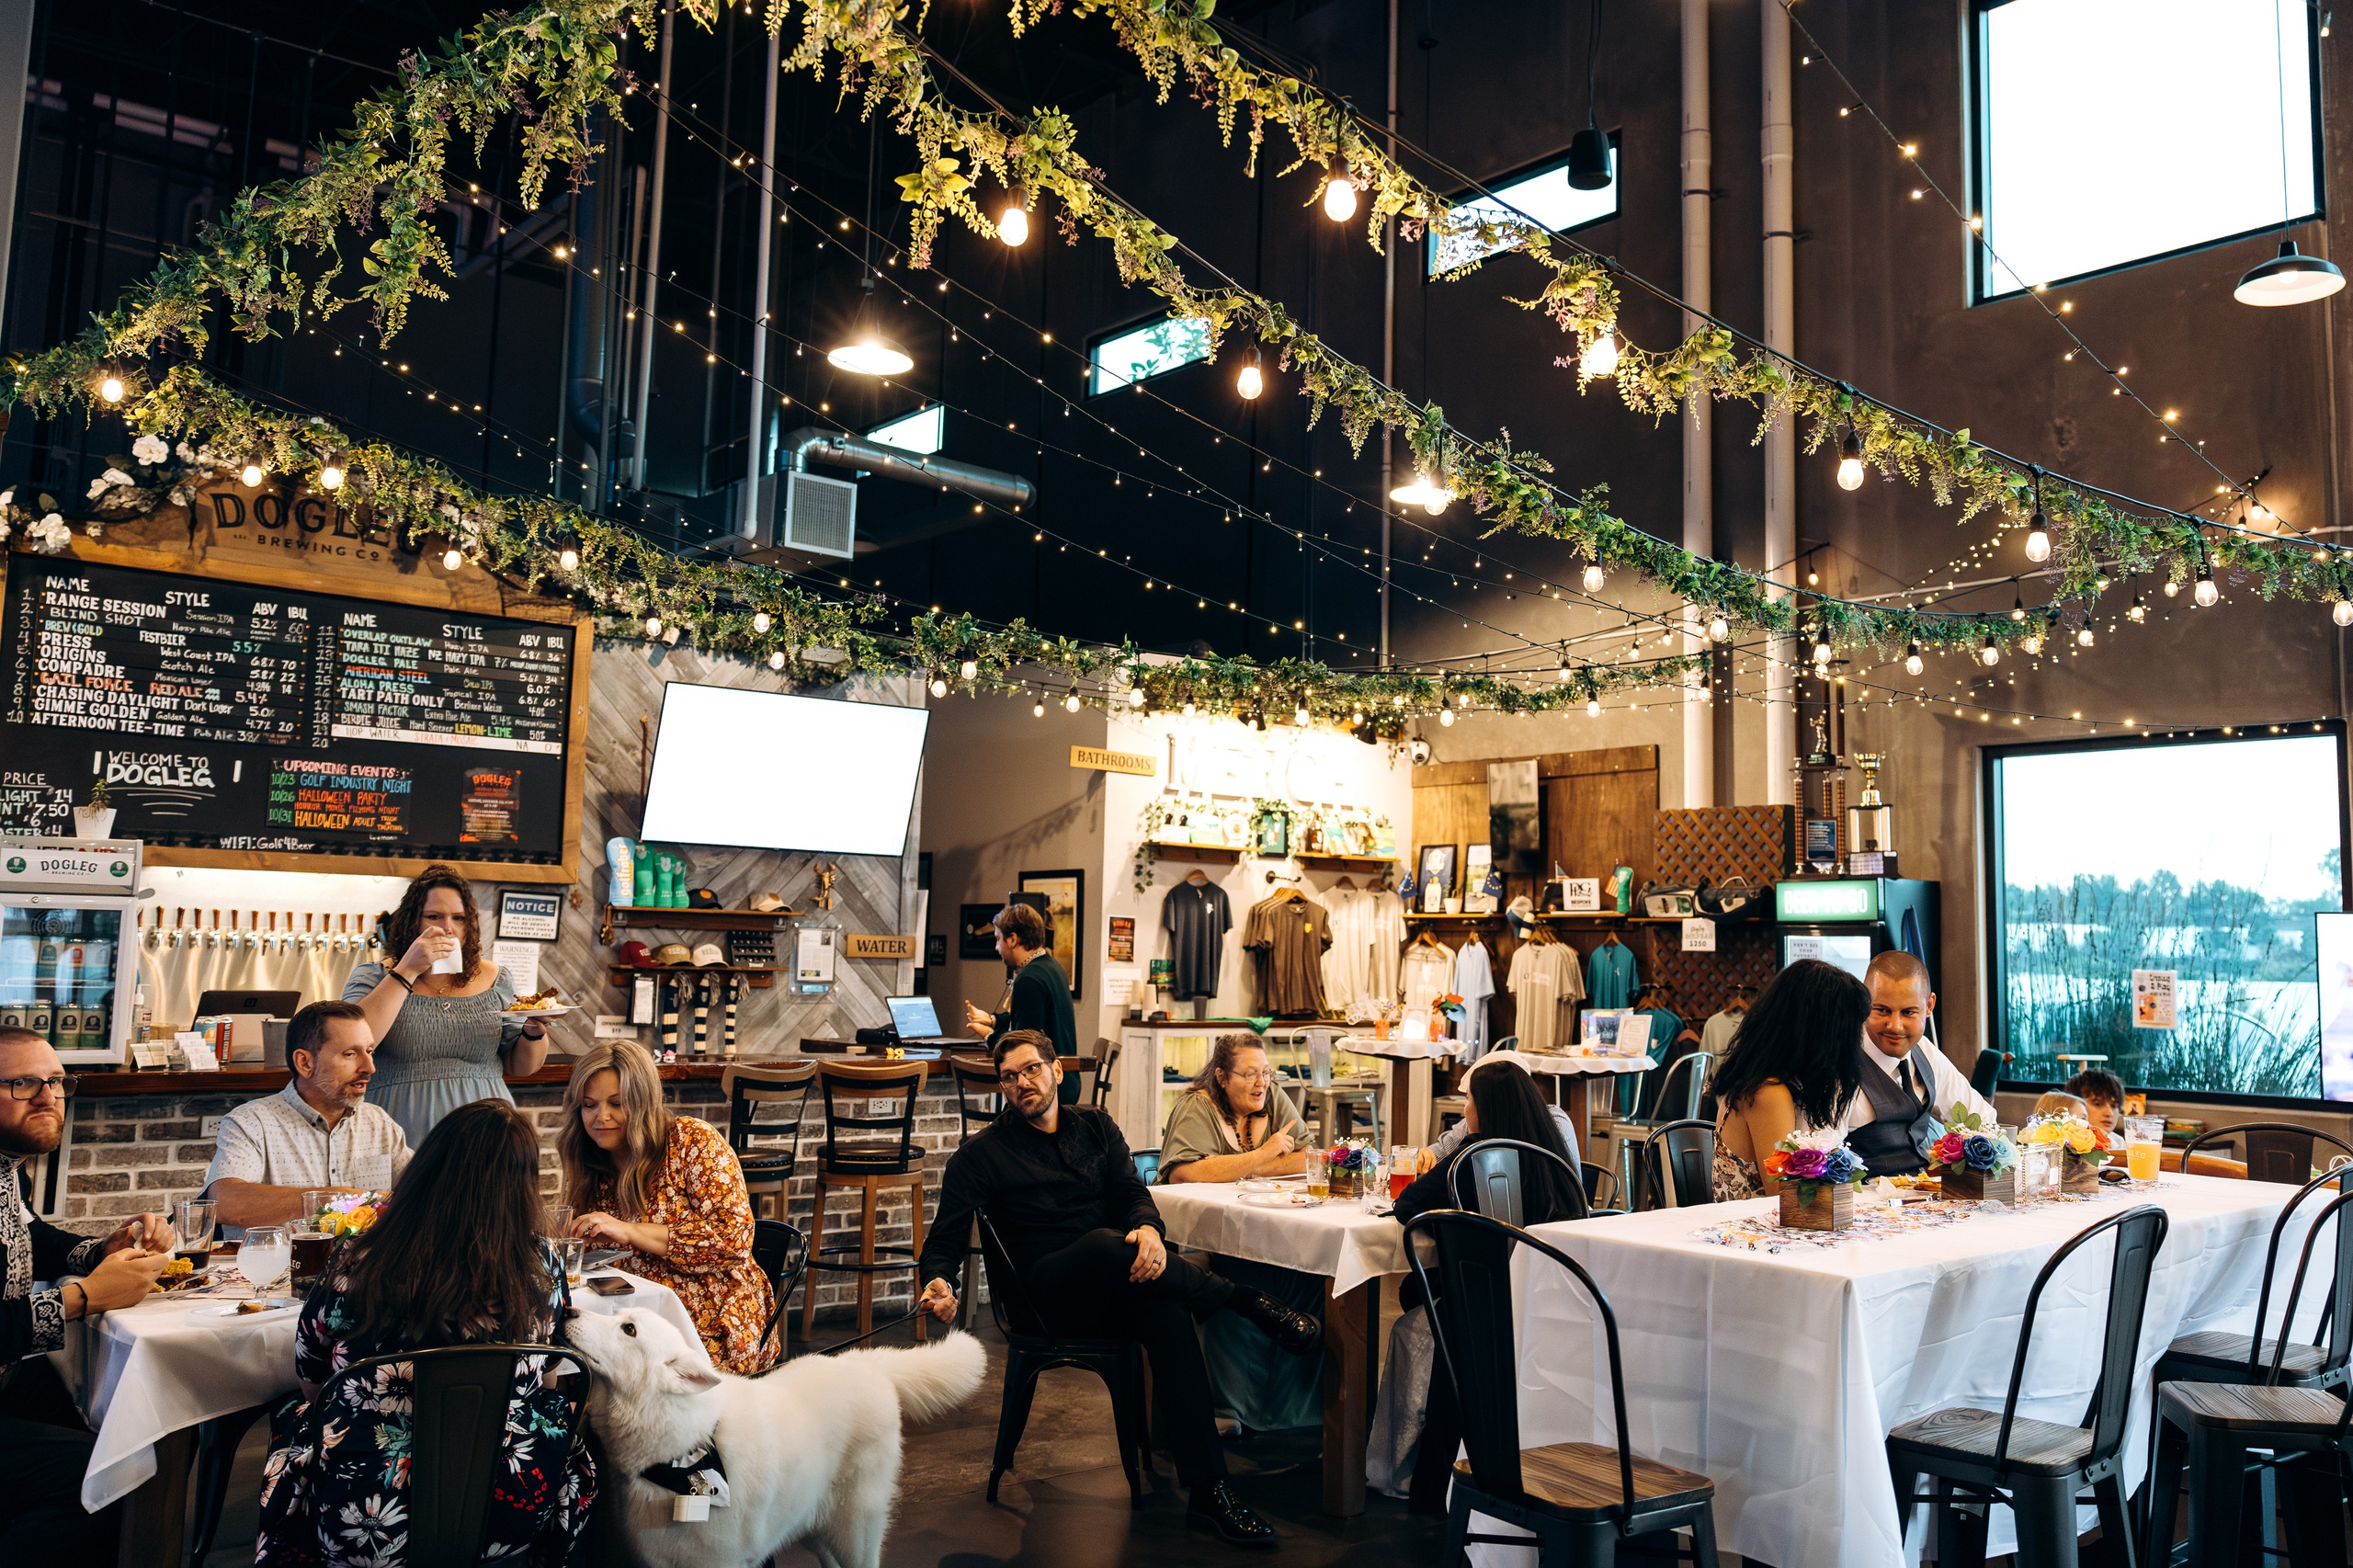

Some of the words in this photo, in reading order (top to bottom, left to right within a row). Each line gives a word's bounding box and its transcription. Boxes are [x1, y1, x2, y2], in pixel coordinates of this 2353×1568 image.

[257, 534, 347, 556] BREWING
[46, 575, 90, 592] NAME
[165, 591, 210, 608] STYLE
[252, 602, 278, 616] ABV
[288, 607, 308, 620] IBU
[46, 591, 100, 610] RANGE
[102, 598, 166, 619] SESSION
[50, 607, 98, 621] BLIND
[105, 613, 145, 627] SHOT
[45, 619, 71, 633] BREW
[77, 623, 103, 636] GOLD
[140, 630, 187, 646] FESTBIER
[343, 613, 377, 627] NAME
[443, 624, 484, 640] STYLE
[519, 634, 540, 647] ABV
[547, 636, 564, 650] IBU
[41, 631, 92, 649] PRESS
[160, 646, 181, 657] West
[184, 649, 213, 661] Coast
[215, 652, 236, 663] IPA
[281, 659, 297, 670] 70
[343, 628, 387, 643] OVERLAP
[389, 635, 433, 648] OUTLAW
[468, 643, 489, 653] IPA
[547, 653, 561, 662] 36
[344, 641, 370, 652] TARA
[428, 649, 443, 661] NZ
[445, 651, 468, 664] HAZY
[469, 653, 486, 666] IPA
[40, 644, 107, 664] ORIGINS
[160, 660, 193, 672] Scotch
[198, 664, 215, 674] Ale
[279, 672, 297, 682] 22
[342, 653, 387, 666] DOGLEG
[393, 658, 419, 670] PALE
[443, 664, 461, 673] Pale
[463, 667, 479, 675] Ale
[545, 675, 558, 685] 34
[38, 658, 126, 679] COMPADRE
[281, 684, 292, 695] 14
[40, 672, 82, 687] GAIL
[85, 676, 134, 692] FORCE
[149, 682, 177, 695] RED
[178, 686, 203, 699] ALE
[344, 665, 395, 681] AMERICAN
[397, 670, 432, 684] STEEL
[527, 683, 551, 694] 6.0%
[36, 684, 104, 702] CHASING
[107, 691, 181, 710] DAYLIGHT
[184, 699, 208, 711] Dark
[209, 702, 234, 714] Lager
[340, 677, 375, 690] ALOHA
[379, 681, 415, 694] PRESS
[443, 688, 473, 699] Tropical
[477, 691, 497, 701] IPA
[543, 697, 557, 707] 60
[340, 687, 375, 701] TART
[376, 690, 410, 705] PATH
[412, 694, 446, 709] ONLY
[454, 699, 481, 710] Berliner
[483, 702, 503, 713] Weiss
[34, 697, 86, 714] GIMME
[89, 703, 150, 721] GOLDEN
[155, 711, 187, 722] Golden
[189, 712, 207, 724] Ale
[278, 721, 294, 733] 20
[341, 713, 372, 727] BIRDIE
[376, 717, 402, 729] JUICE
[344, 701, 375, 714] SMASH
[377, 703, 410, 718] FACTOR
[424, 709, 444, 721] Extra
[31, 712, 116, 731] AFTERNOON
[119, 720, 186, 737] TEE-TIME
[193, 728, 212, 738] Pub
[346, 727, 364, 737] HOP
[369, 729, 400, 739] WATER
[414, 733, 443, 743] STRATA
[450, 734, 478, 746] MOSAIC
[516, 741, 528, 752] NA
[108, 750, 183, 767] WELCOME
[188, 756, 209, 768] TO
[283, 760, 347, 775] UPCOMING
[1078, 750, 1151, 771] BATHROOMS
[3, 772, 46, 786] PRICE
[106, 763, 216, 788] DOGLEG
[300, 773, 327, 787] GOLF
[330, 776, 377, 791] INDUSTRY
[382, 779, 412, 794] NIGHT
[294, 802, 321, 811] HORROR
[378, 807, 401, 815] NIGHT
[298, 789, 352, 804] HALLOWEEN
[357, 791, 388, 806] PARTY
[295, 811, 351, 829] HALLOWEEN
[353, 817, 377, 827] ADULT
[40, 859, 98, 873] DOGLEG
[506, 901, 555, 913] NOTICE
[856, 939, 907, 954] WATER
